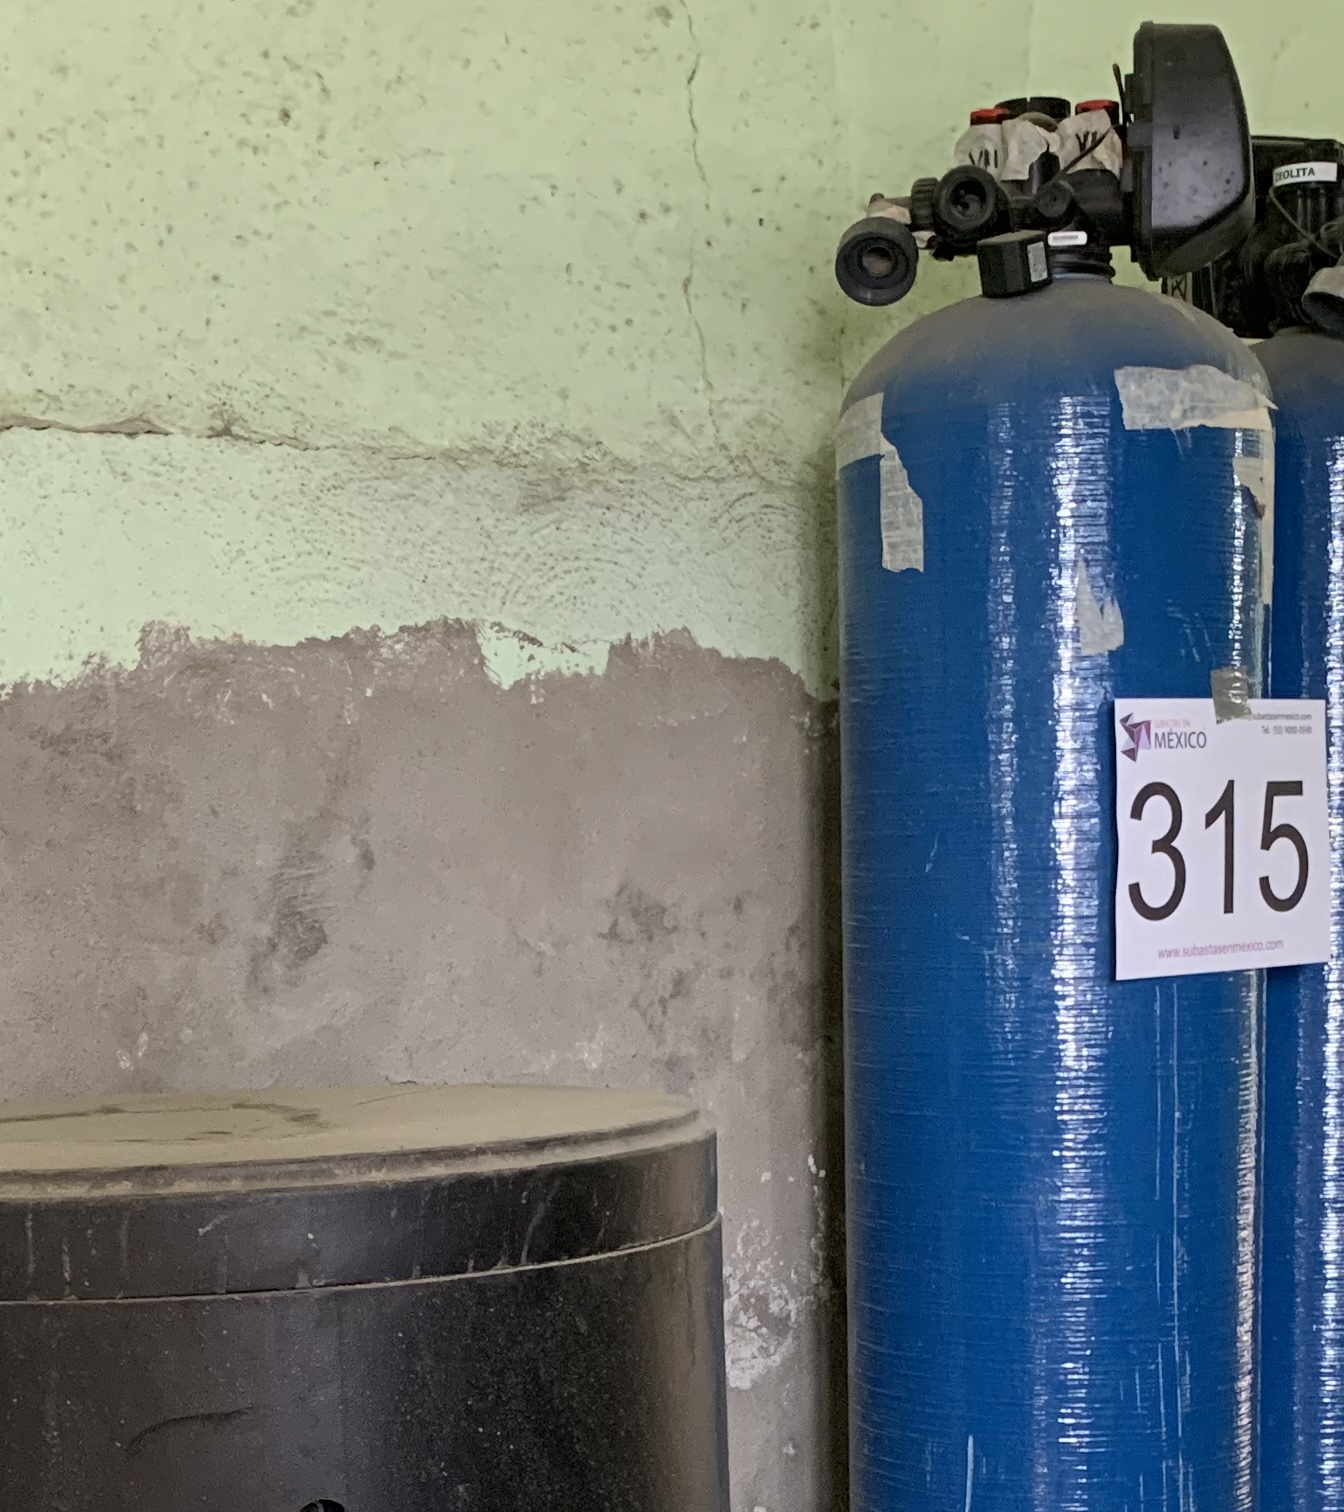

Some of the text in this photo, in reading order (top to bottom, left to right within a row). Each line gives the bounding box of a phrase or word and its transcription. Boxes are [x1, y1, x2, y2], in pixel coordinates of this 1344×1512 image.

[1274, 167, 1316, 183] ZEOLITA
[1154, 728, 1207, 750] MÉXICO
[1128, 779, 1309, 921] 315
[1157, 938, 1284, 960] www.subastasenmexico.com
